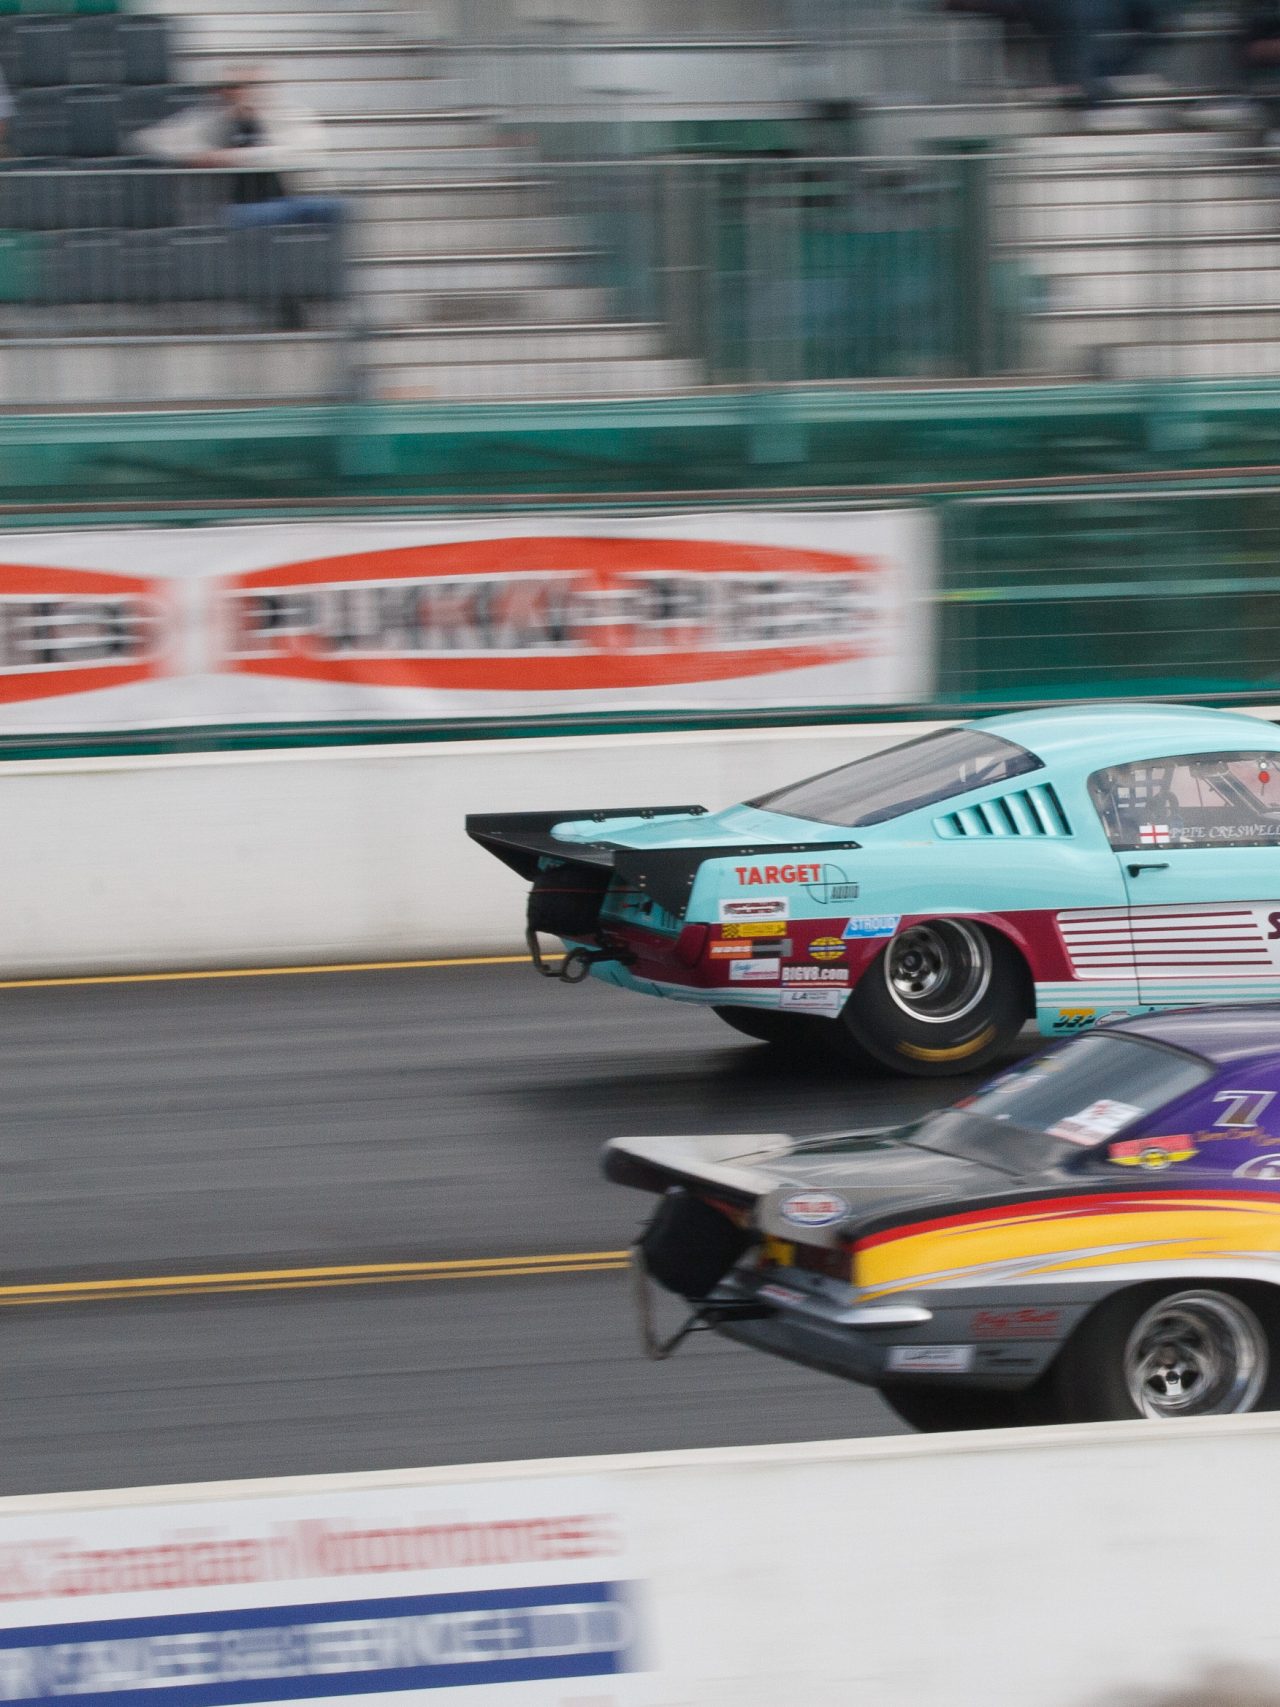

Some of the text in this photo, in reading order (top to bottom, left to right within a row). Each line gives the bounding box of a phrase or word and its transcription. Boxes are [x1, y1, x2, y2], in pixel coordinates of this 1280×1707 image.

[1169, 826, 1206, 838] PETE
[735, 864, 821, 885] TARGET
[850, 916, 899, 931] STROUD
